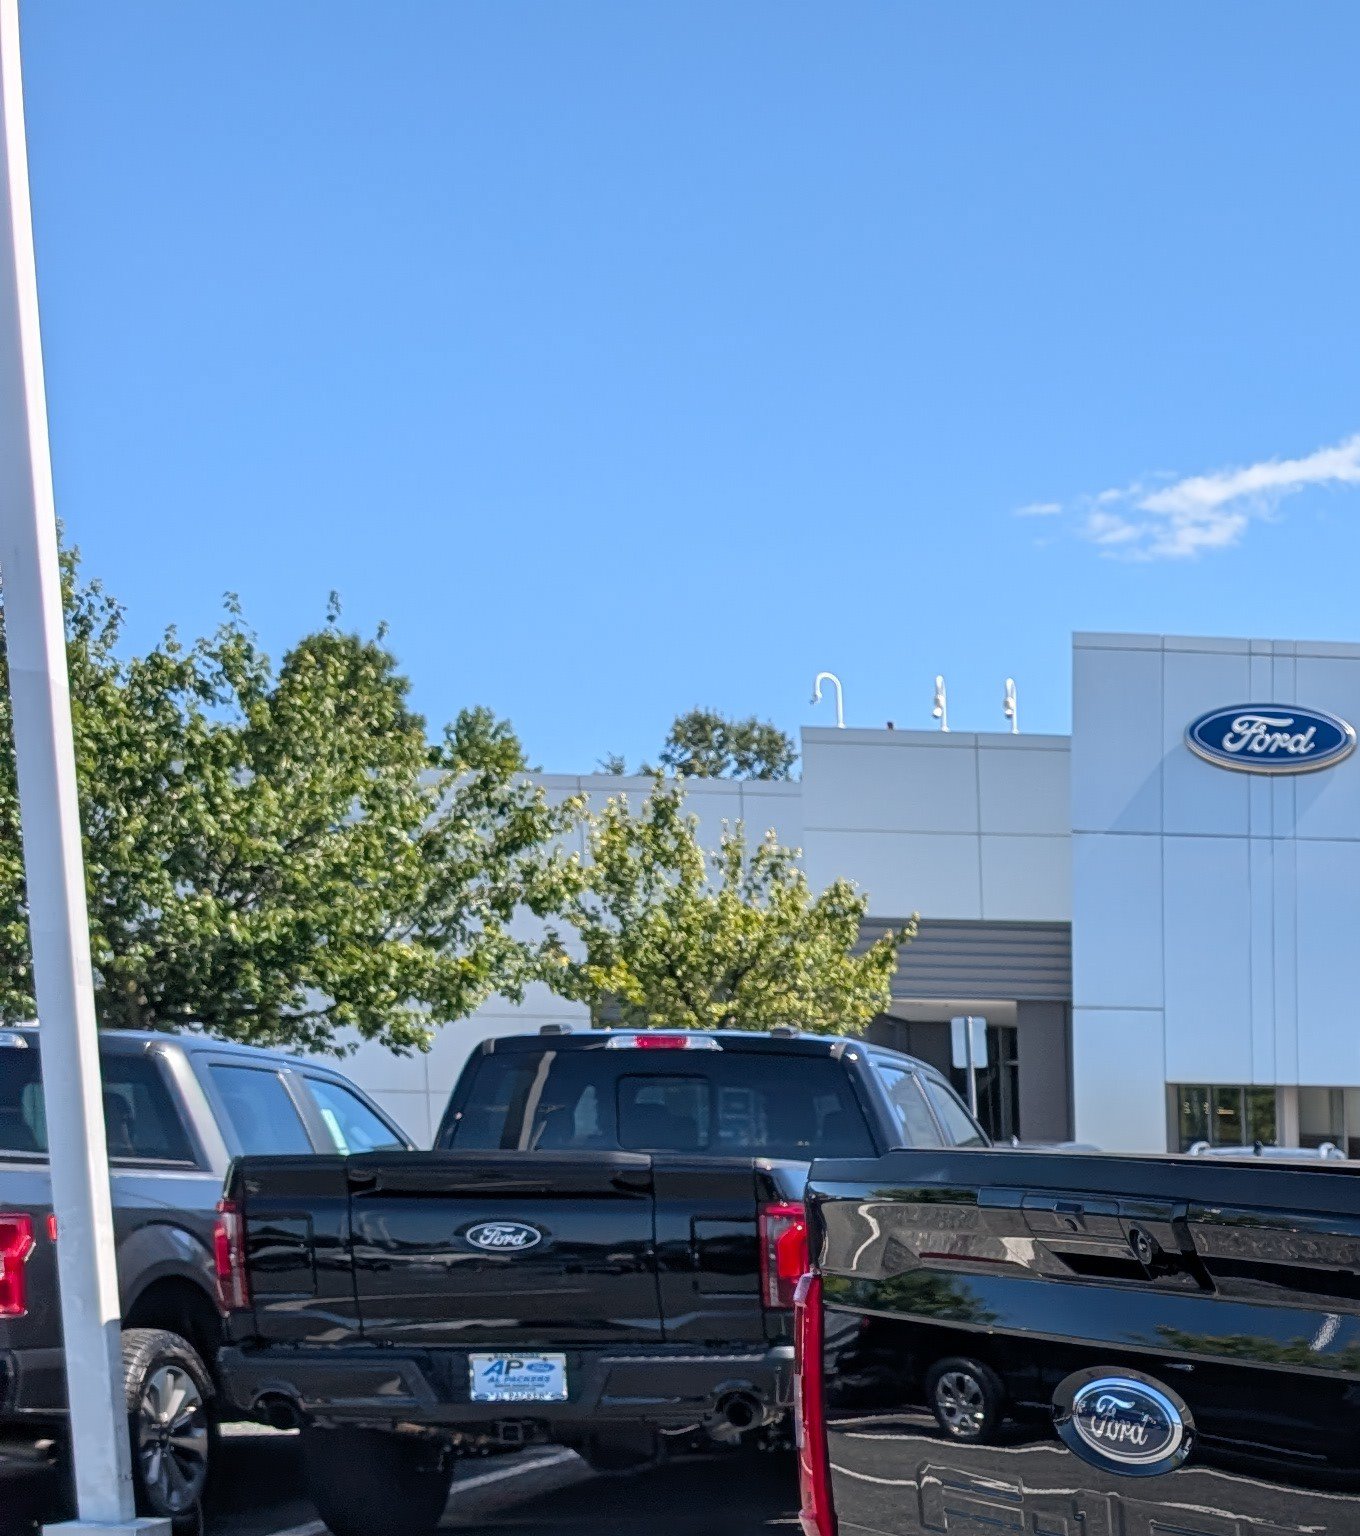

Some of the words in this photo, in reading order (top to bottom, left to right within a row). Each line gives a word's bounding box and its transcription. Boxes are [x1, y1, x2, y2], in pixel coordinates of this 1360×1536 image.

[1222, 715, 1317, 754] Ford
[479, 1226, 527, 1246] Ford
[481, 1360, 524, 1377] AP
[1091, 1395, 1149, 1446] Ford
